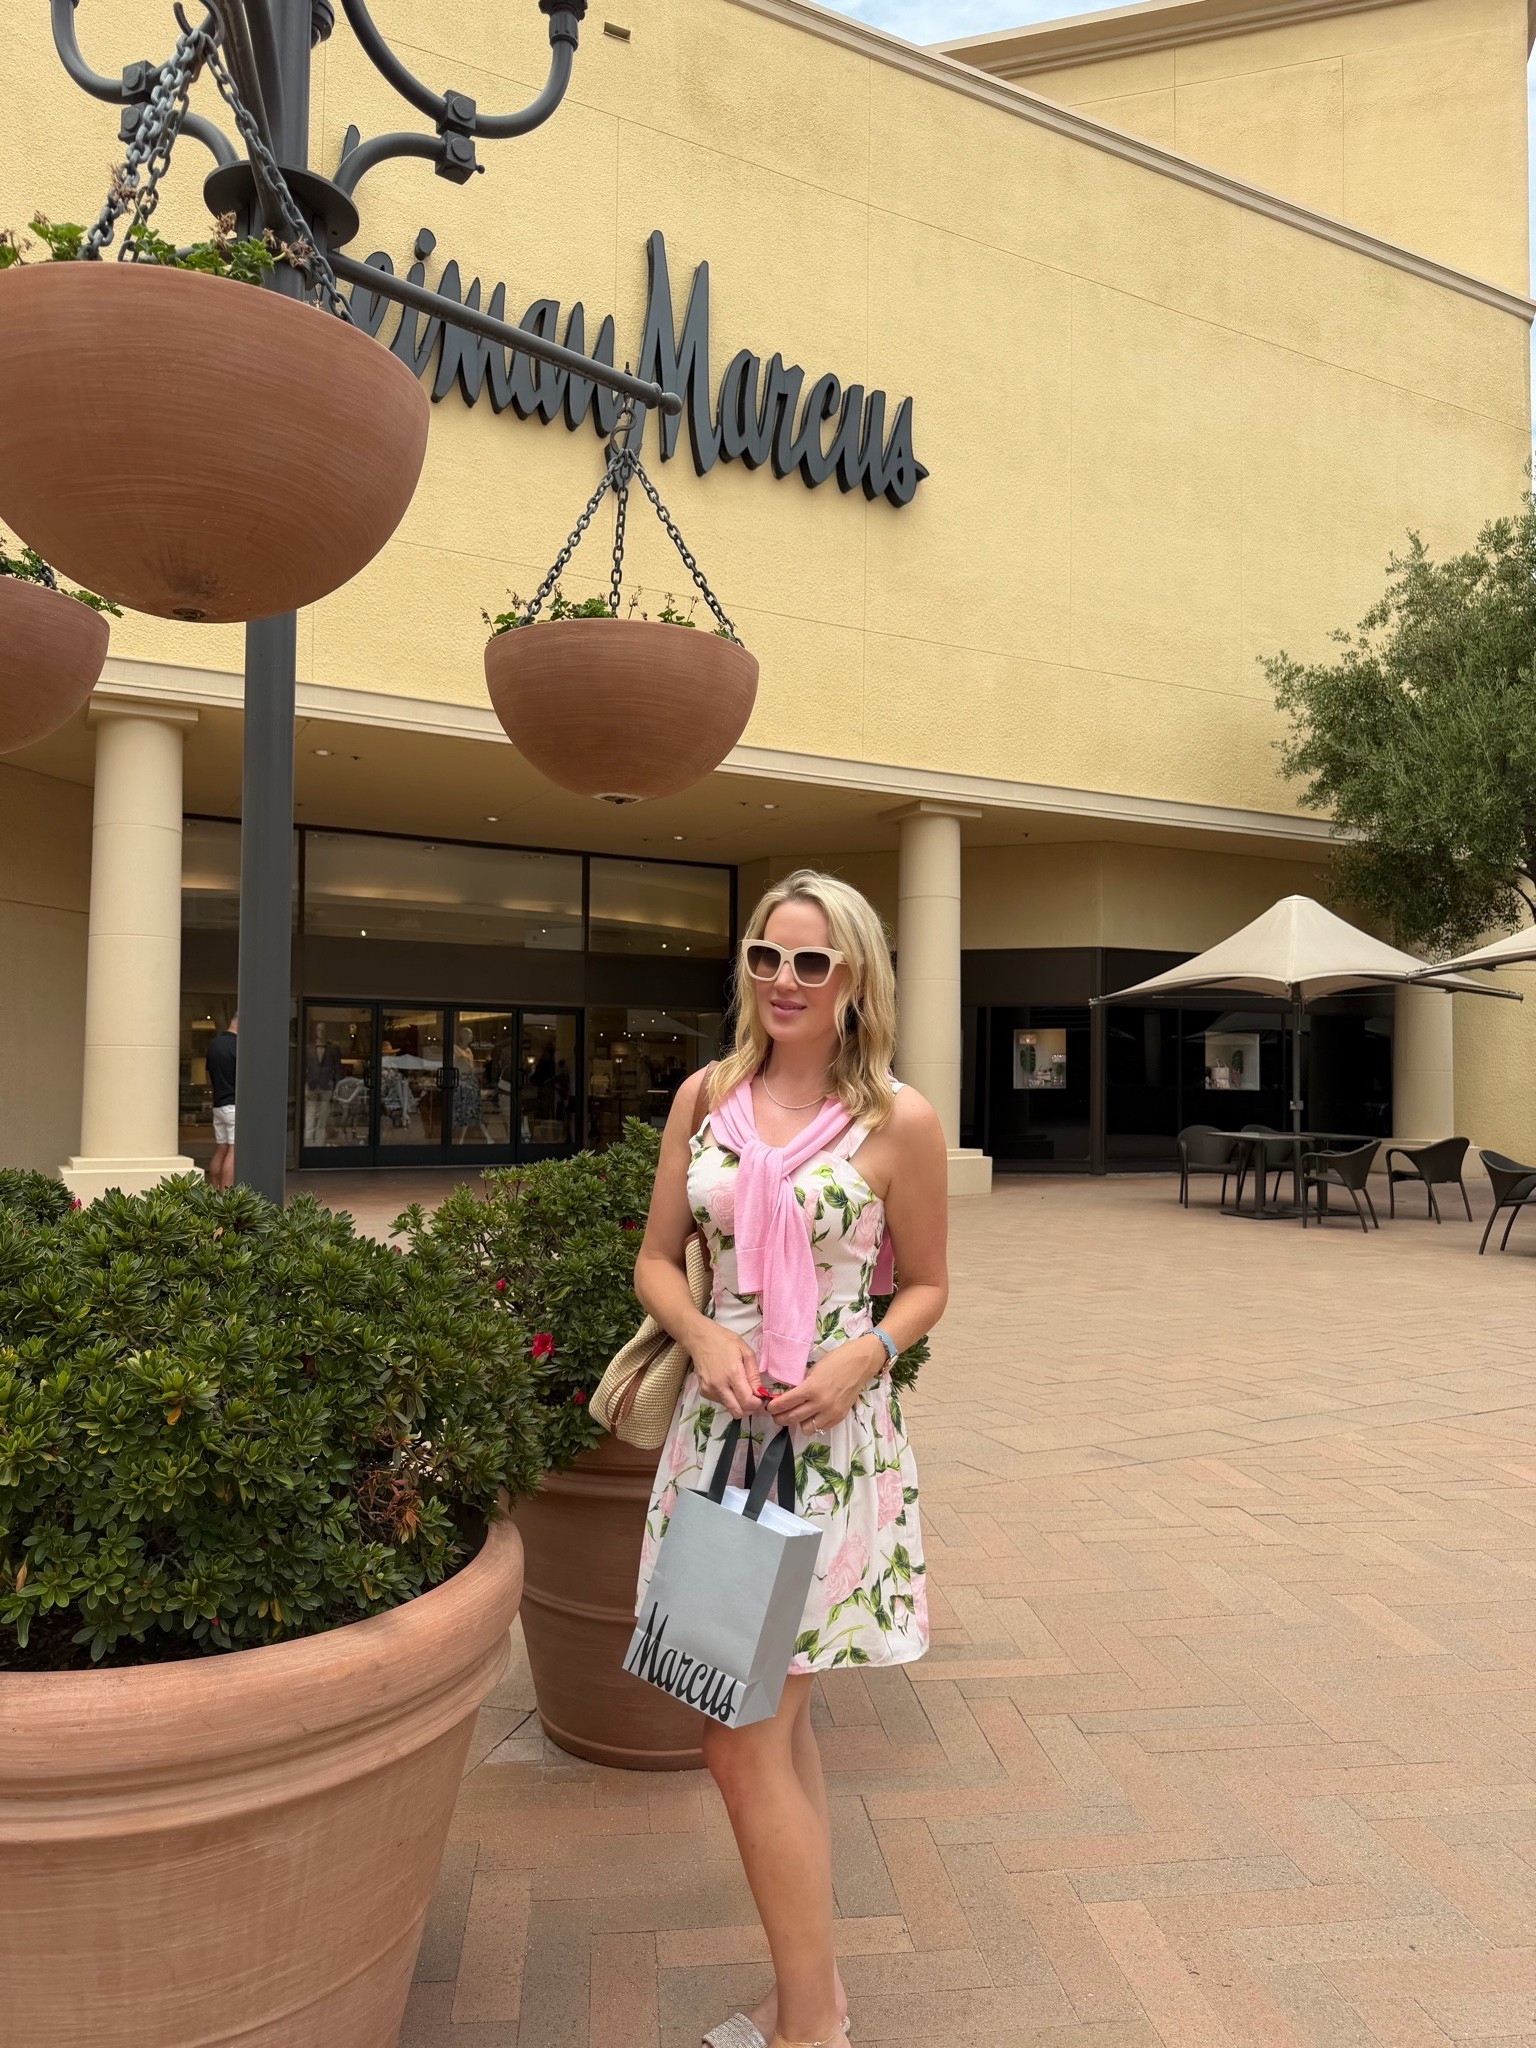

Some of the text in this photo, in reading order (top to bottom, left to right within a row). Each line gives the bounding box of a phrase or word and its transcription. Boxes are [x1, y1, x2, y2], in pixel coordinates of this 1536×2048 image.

[308, 125, 930, 508] eiman Marcus
[628, 1601, 736, 1722] Marcus
